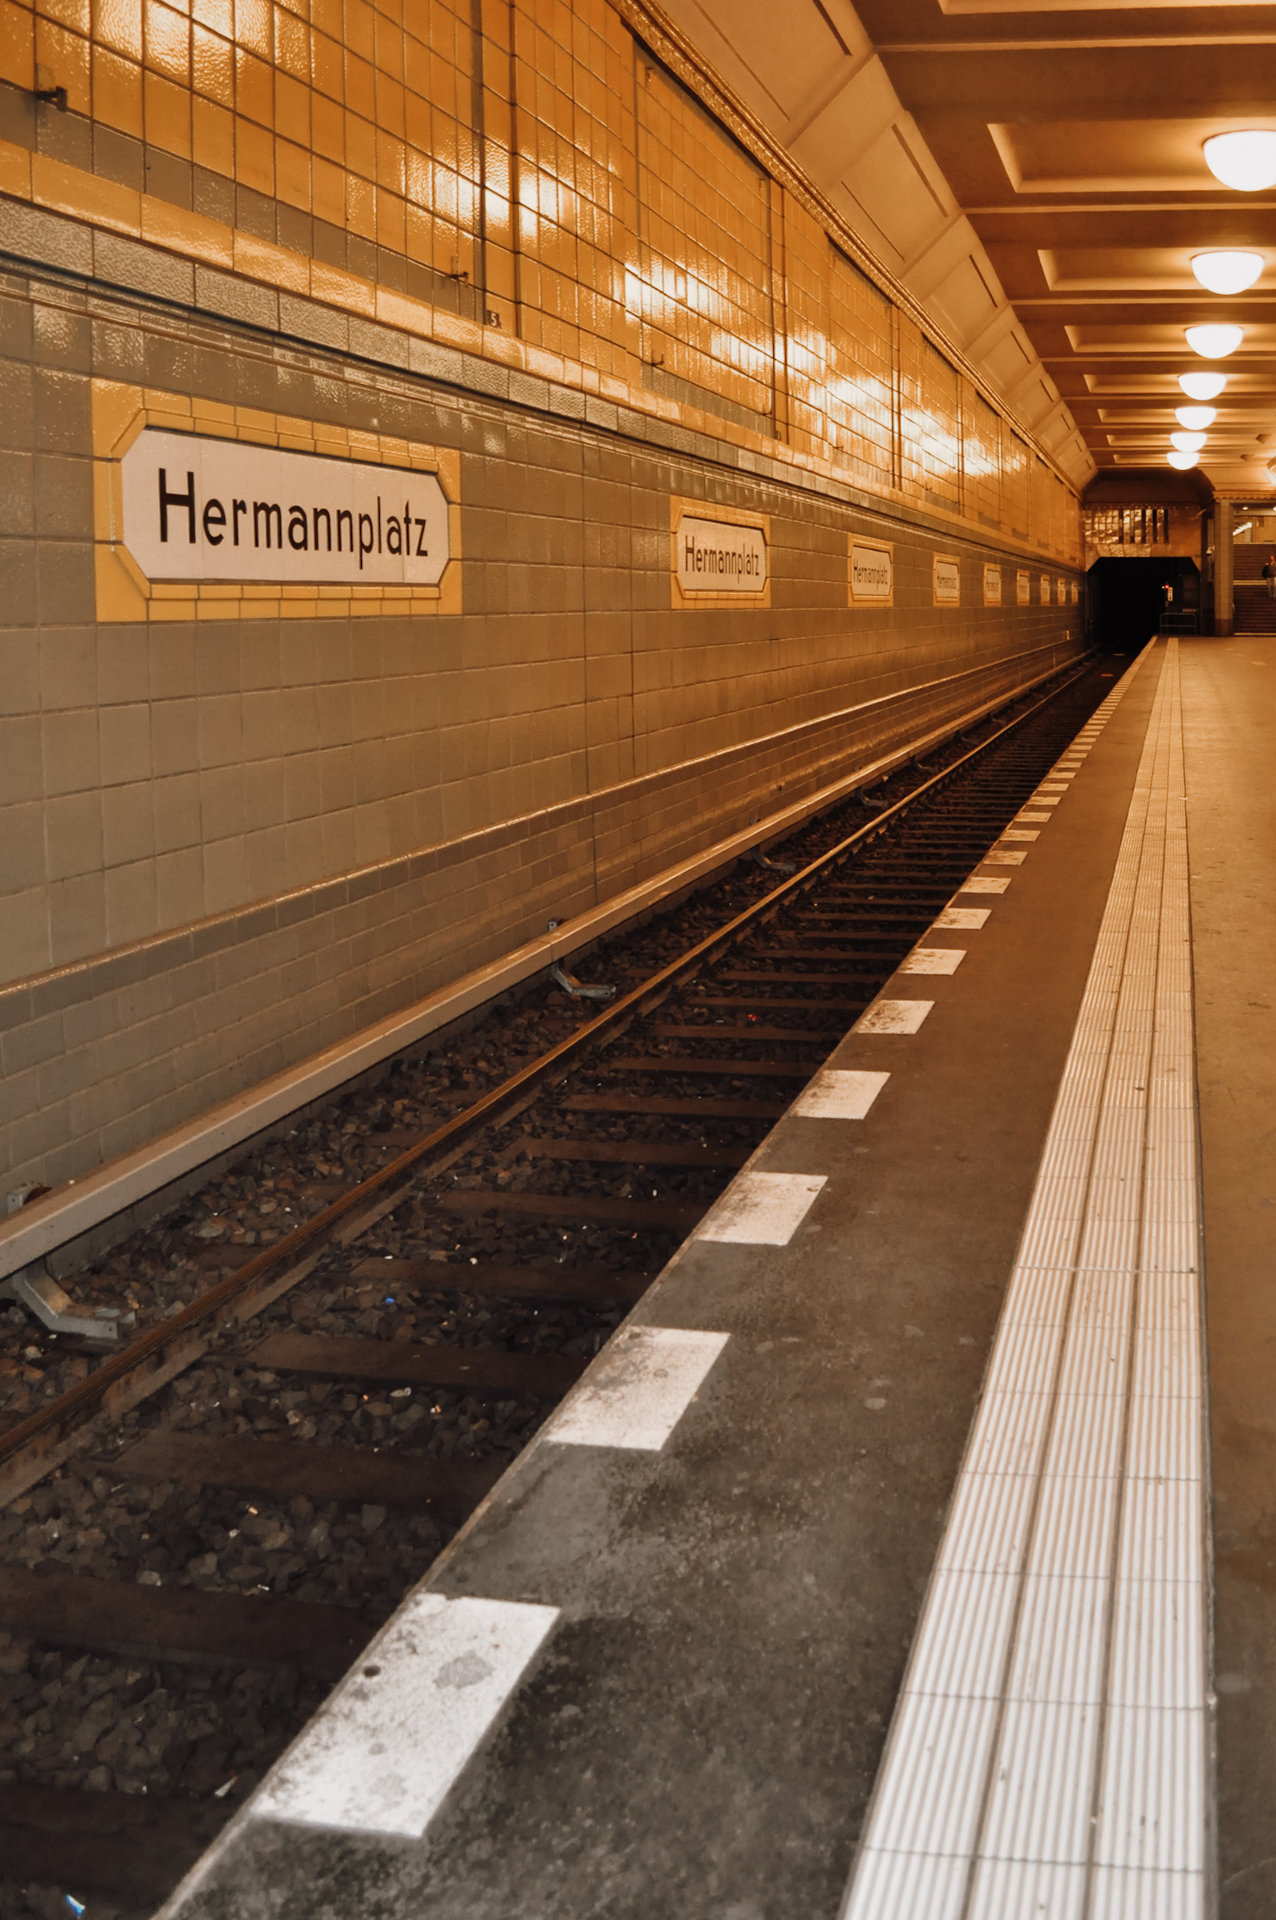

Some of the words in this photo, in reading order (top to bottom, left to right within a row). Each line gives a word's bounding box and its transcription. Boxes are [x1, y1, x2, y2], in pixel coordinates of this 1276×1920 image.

[490, 312, 498, 327] 5
[158, 467, 429, 570] Hermannplatz
[685, 534, 759, 584] Hermannplatz
